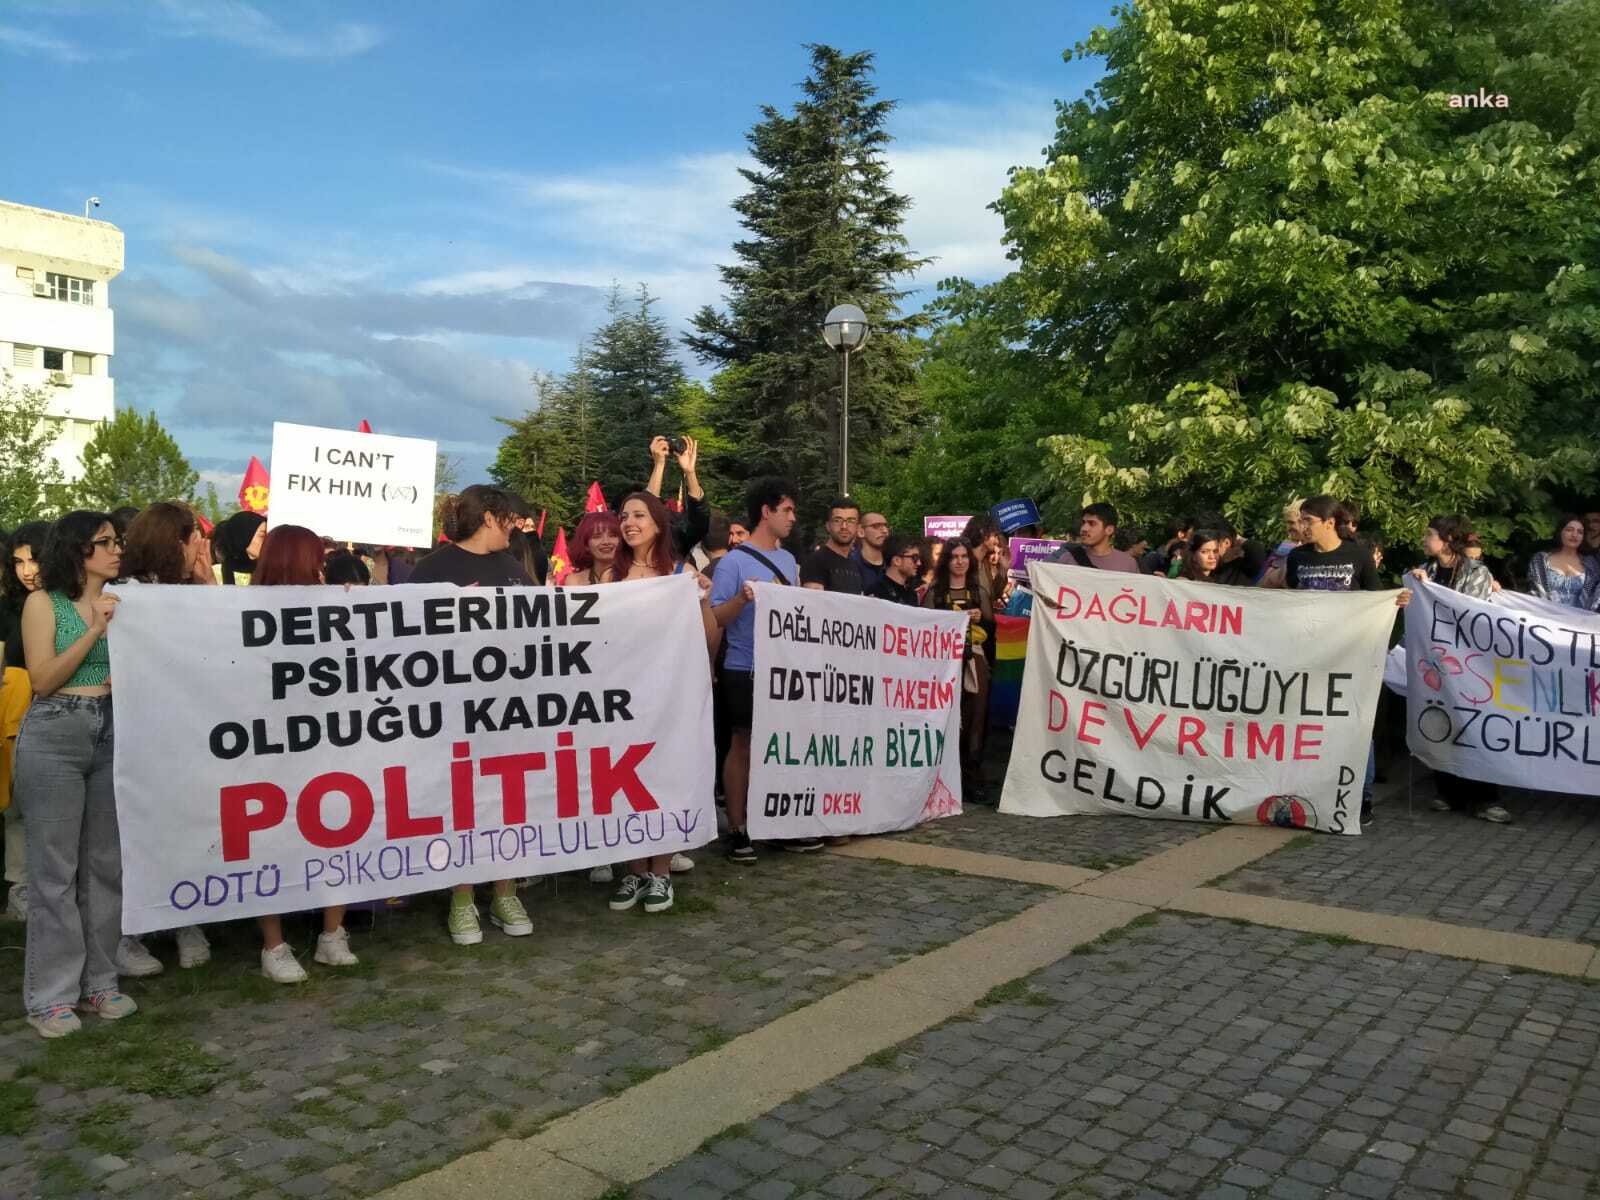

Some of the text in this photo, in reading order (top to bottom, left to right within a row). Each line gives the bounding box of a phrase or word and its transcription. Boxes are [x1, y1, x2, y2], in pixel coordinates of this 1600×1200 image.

[288, 473, 321, 494] FIX
[329, 478, 372, 498] HIM
[314, 446, 394, 471] I CAN'T
[242, 587, 601, 647] DERTLERİMİZ
[769, 606, 876, 651] DAĞLARDAN
[1057, 587, 1244, 635] DAĞLARIN
[272, 635, 592, 699] PSİKOLOJİK
[769, 664, 874, 706] ODTÜDEN
[1056, 638, 1353, 717] ÖZGÜRLÜĞÜYLE
[209, 689, 634, 759] OLDUĞU KADAR
[764, 732, 874, 767] ALANLAR
[1048, 689, 1324, 762] DEVRİME
[1418, 700, 1600, 765] ÖZGÜRL
[220, 731, 660, 862] POLİTİK
[764, 787, 862, 817] ODTÜ DKSK
[1040, 750, 1233, 822] GELDİK
[170, 863, 280, 910] ODTÜ
[305, 830, 474, 891] PSİKOLOJİ
[481, 812, 665, 861] TOPLULUĞU
